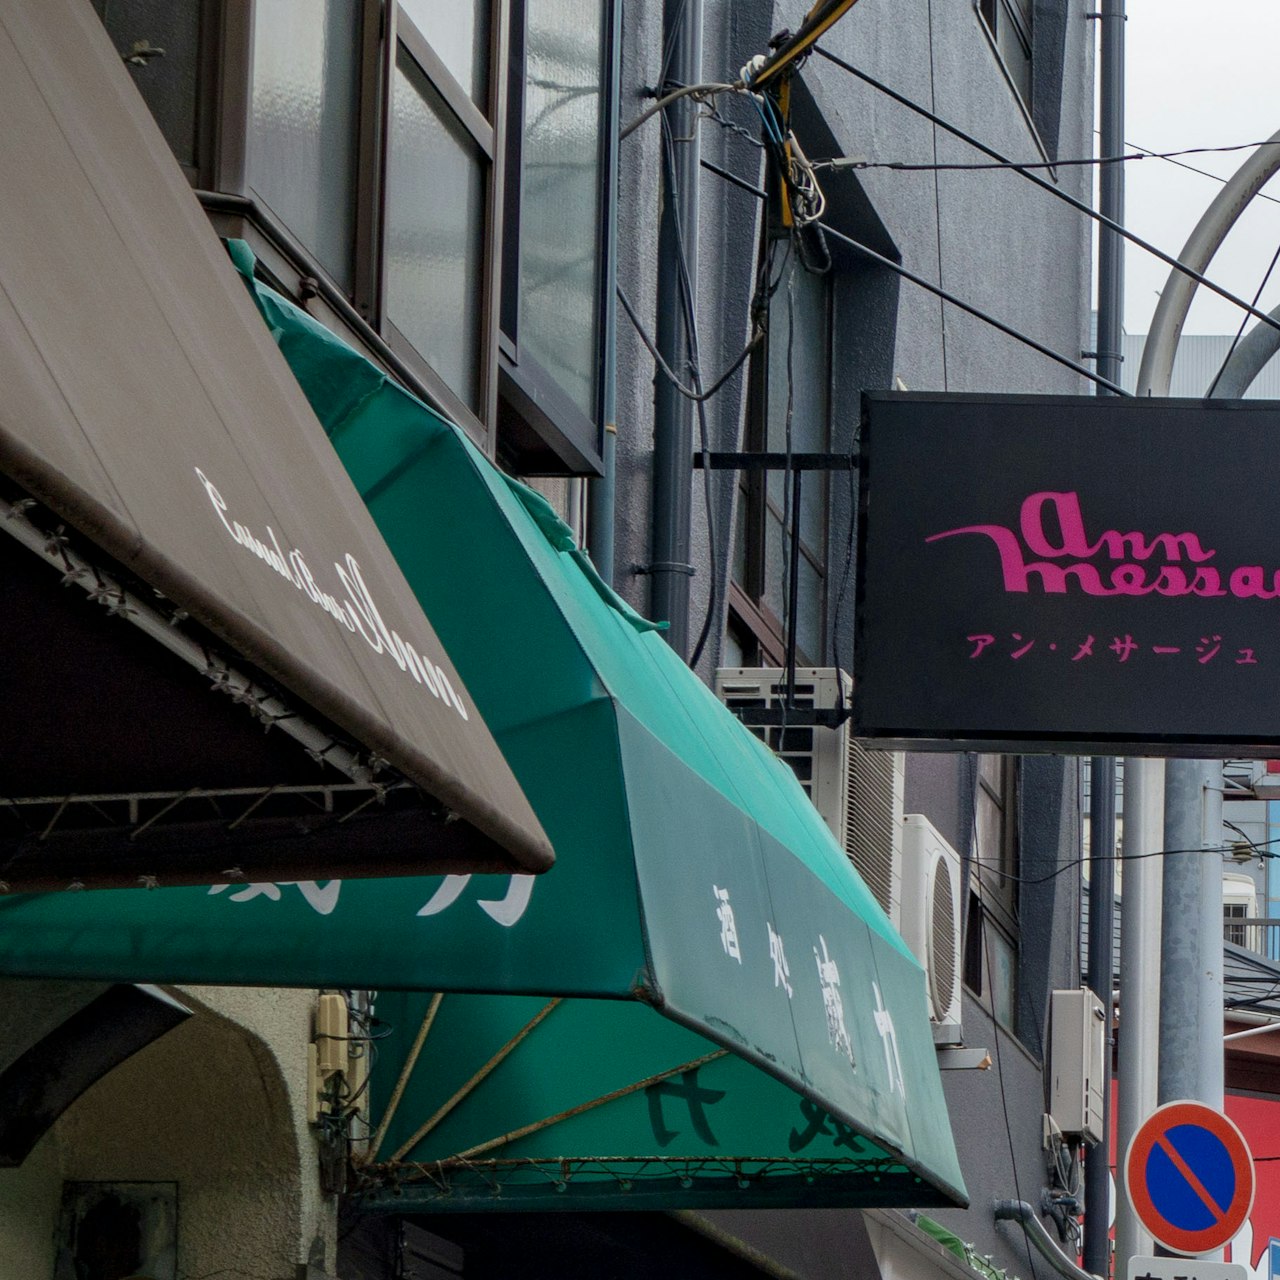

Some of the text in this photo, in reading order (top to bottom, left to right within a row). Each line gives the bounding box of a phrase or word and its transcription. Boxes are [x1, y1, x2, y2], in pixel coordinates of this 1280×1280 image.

[965, 633, 1259, 667] アン・メサージュ
